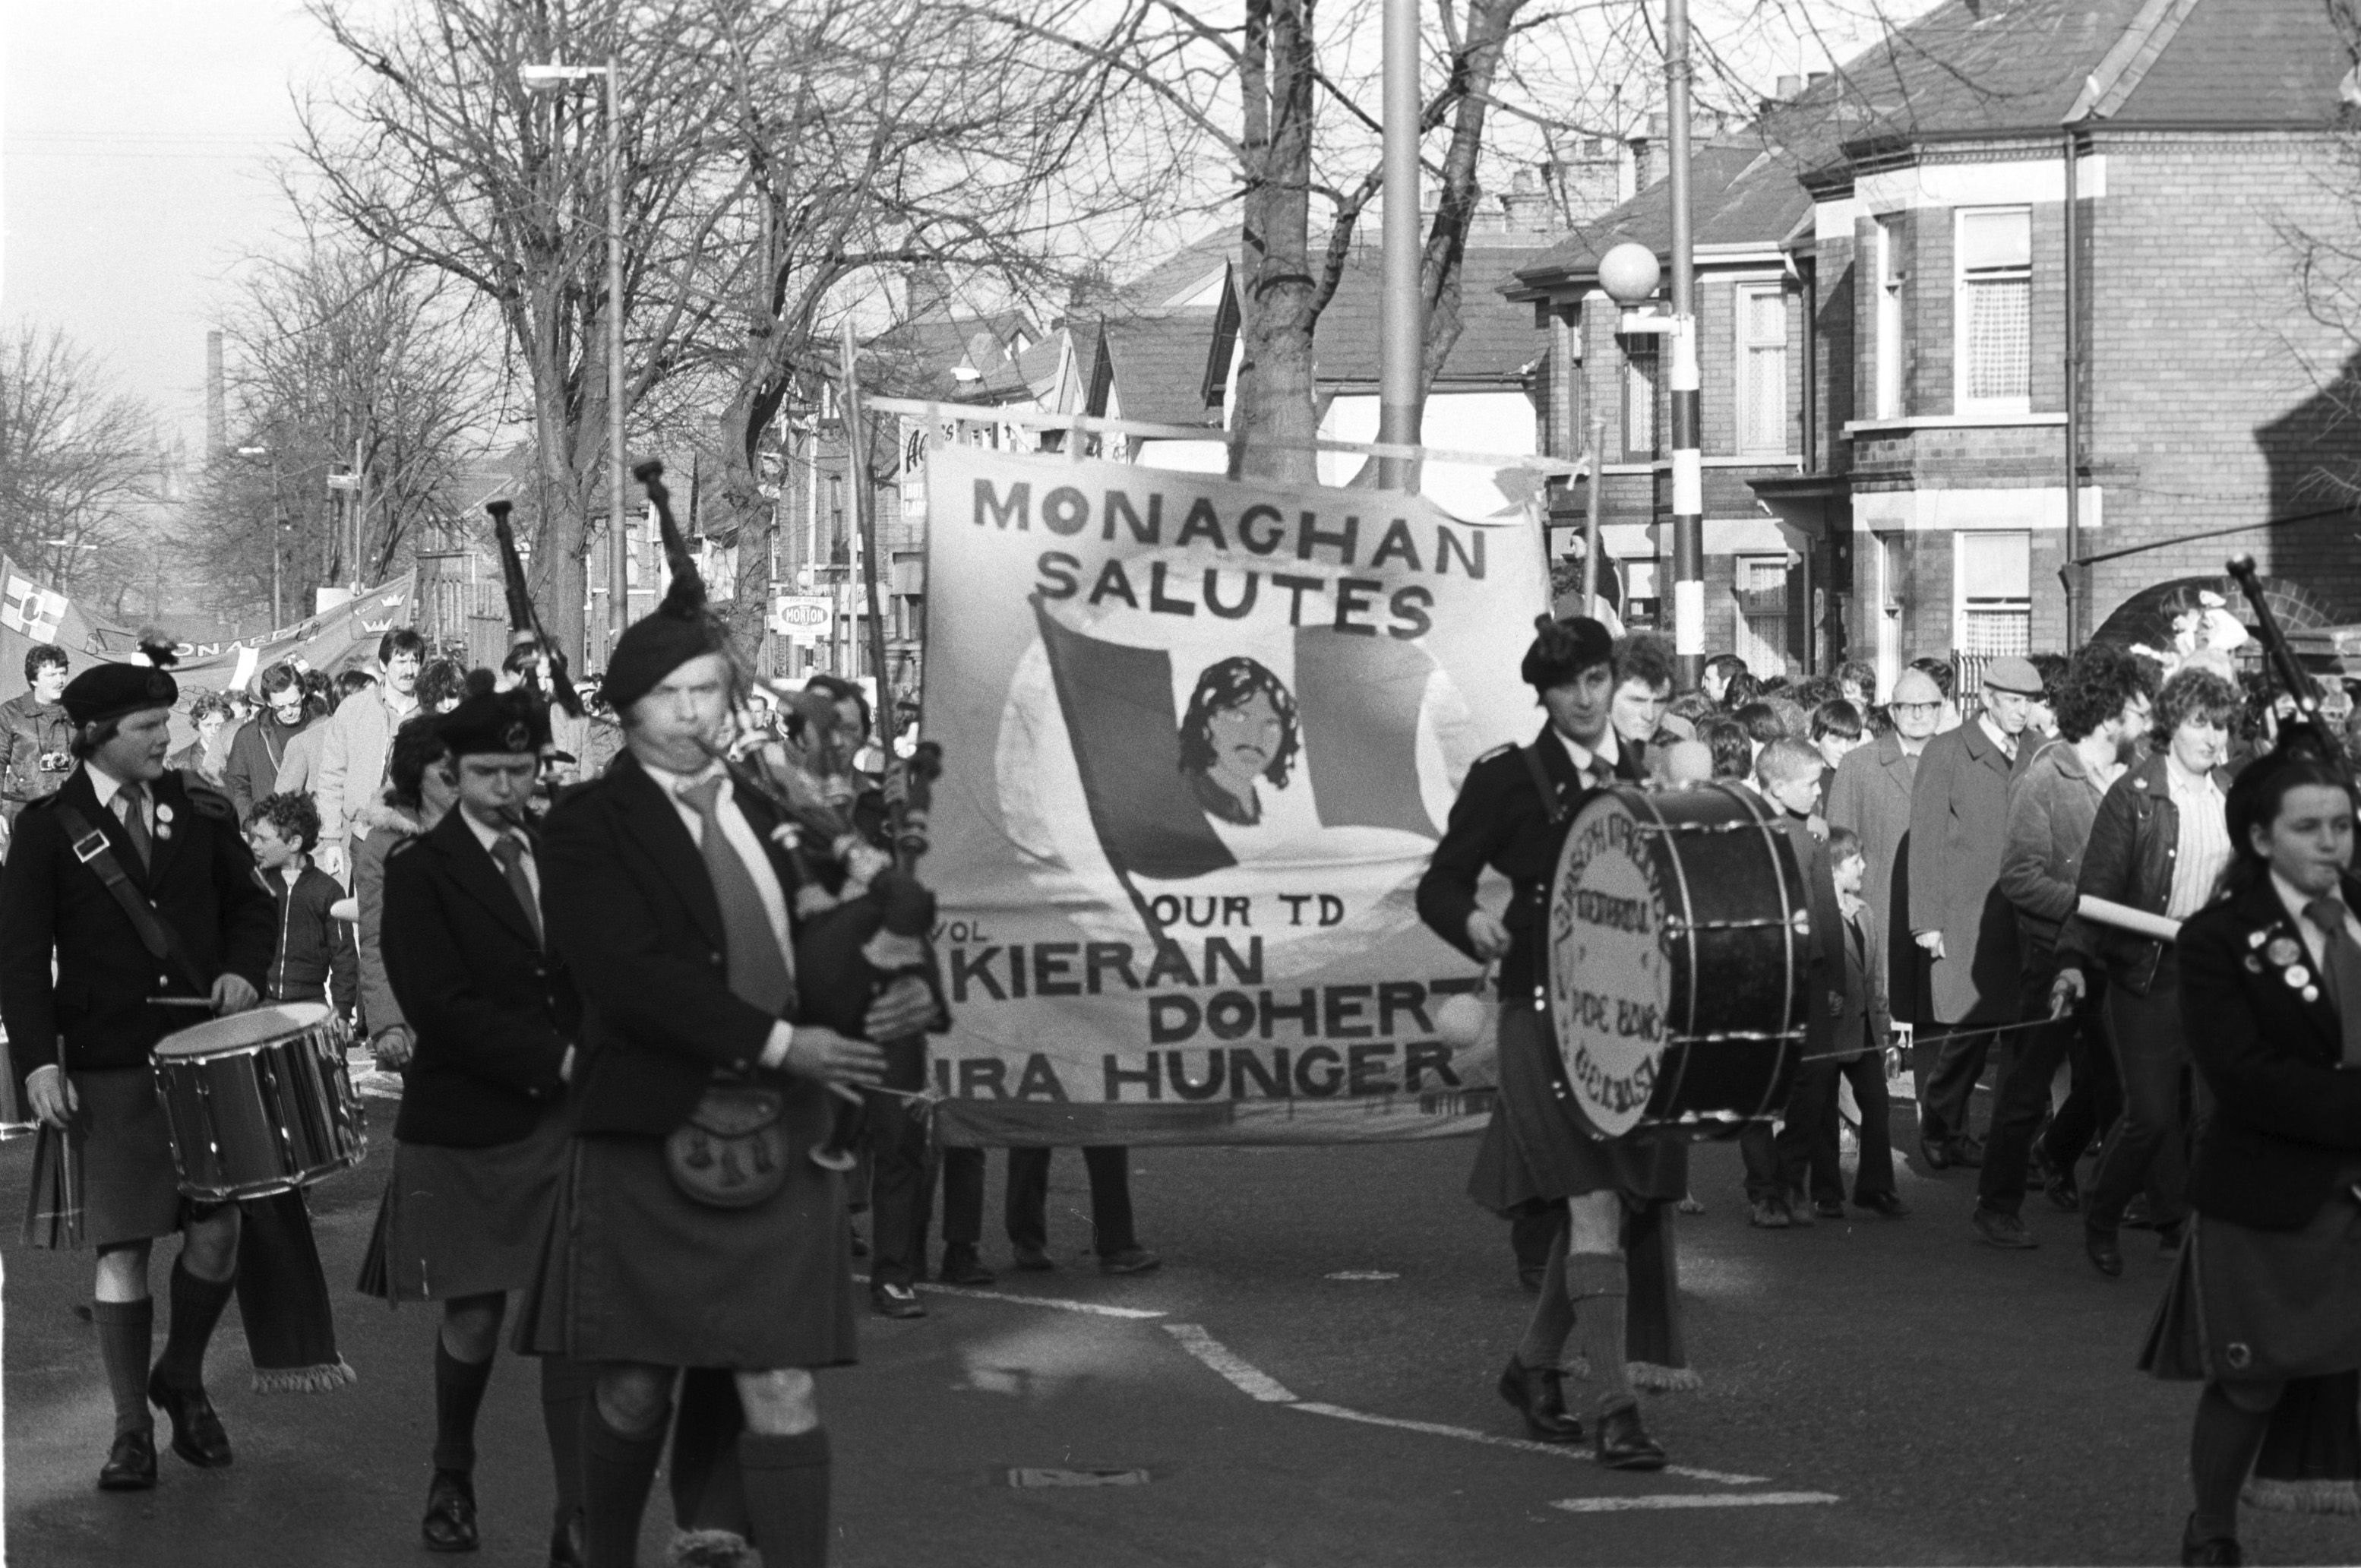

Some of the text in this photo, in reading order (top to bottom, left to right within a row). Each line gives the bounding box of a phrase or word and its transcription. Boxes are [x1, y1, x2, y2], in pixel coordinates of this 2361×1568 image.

[972, 476, 1487, 580] MONAGHAN
[785, 609, 823, 623] MORTON
[1036, 550, 1435, 640] SALUTES
[1151, 893, 1345, 927] OUR TD
[950, 935, 1263, 1003] KIERAN
[935, 1041, 1461, 1102] IRA HUNGER
